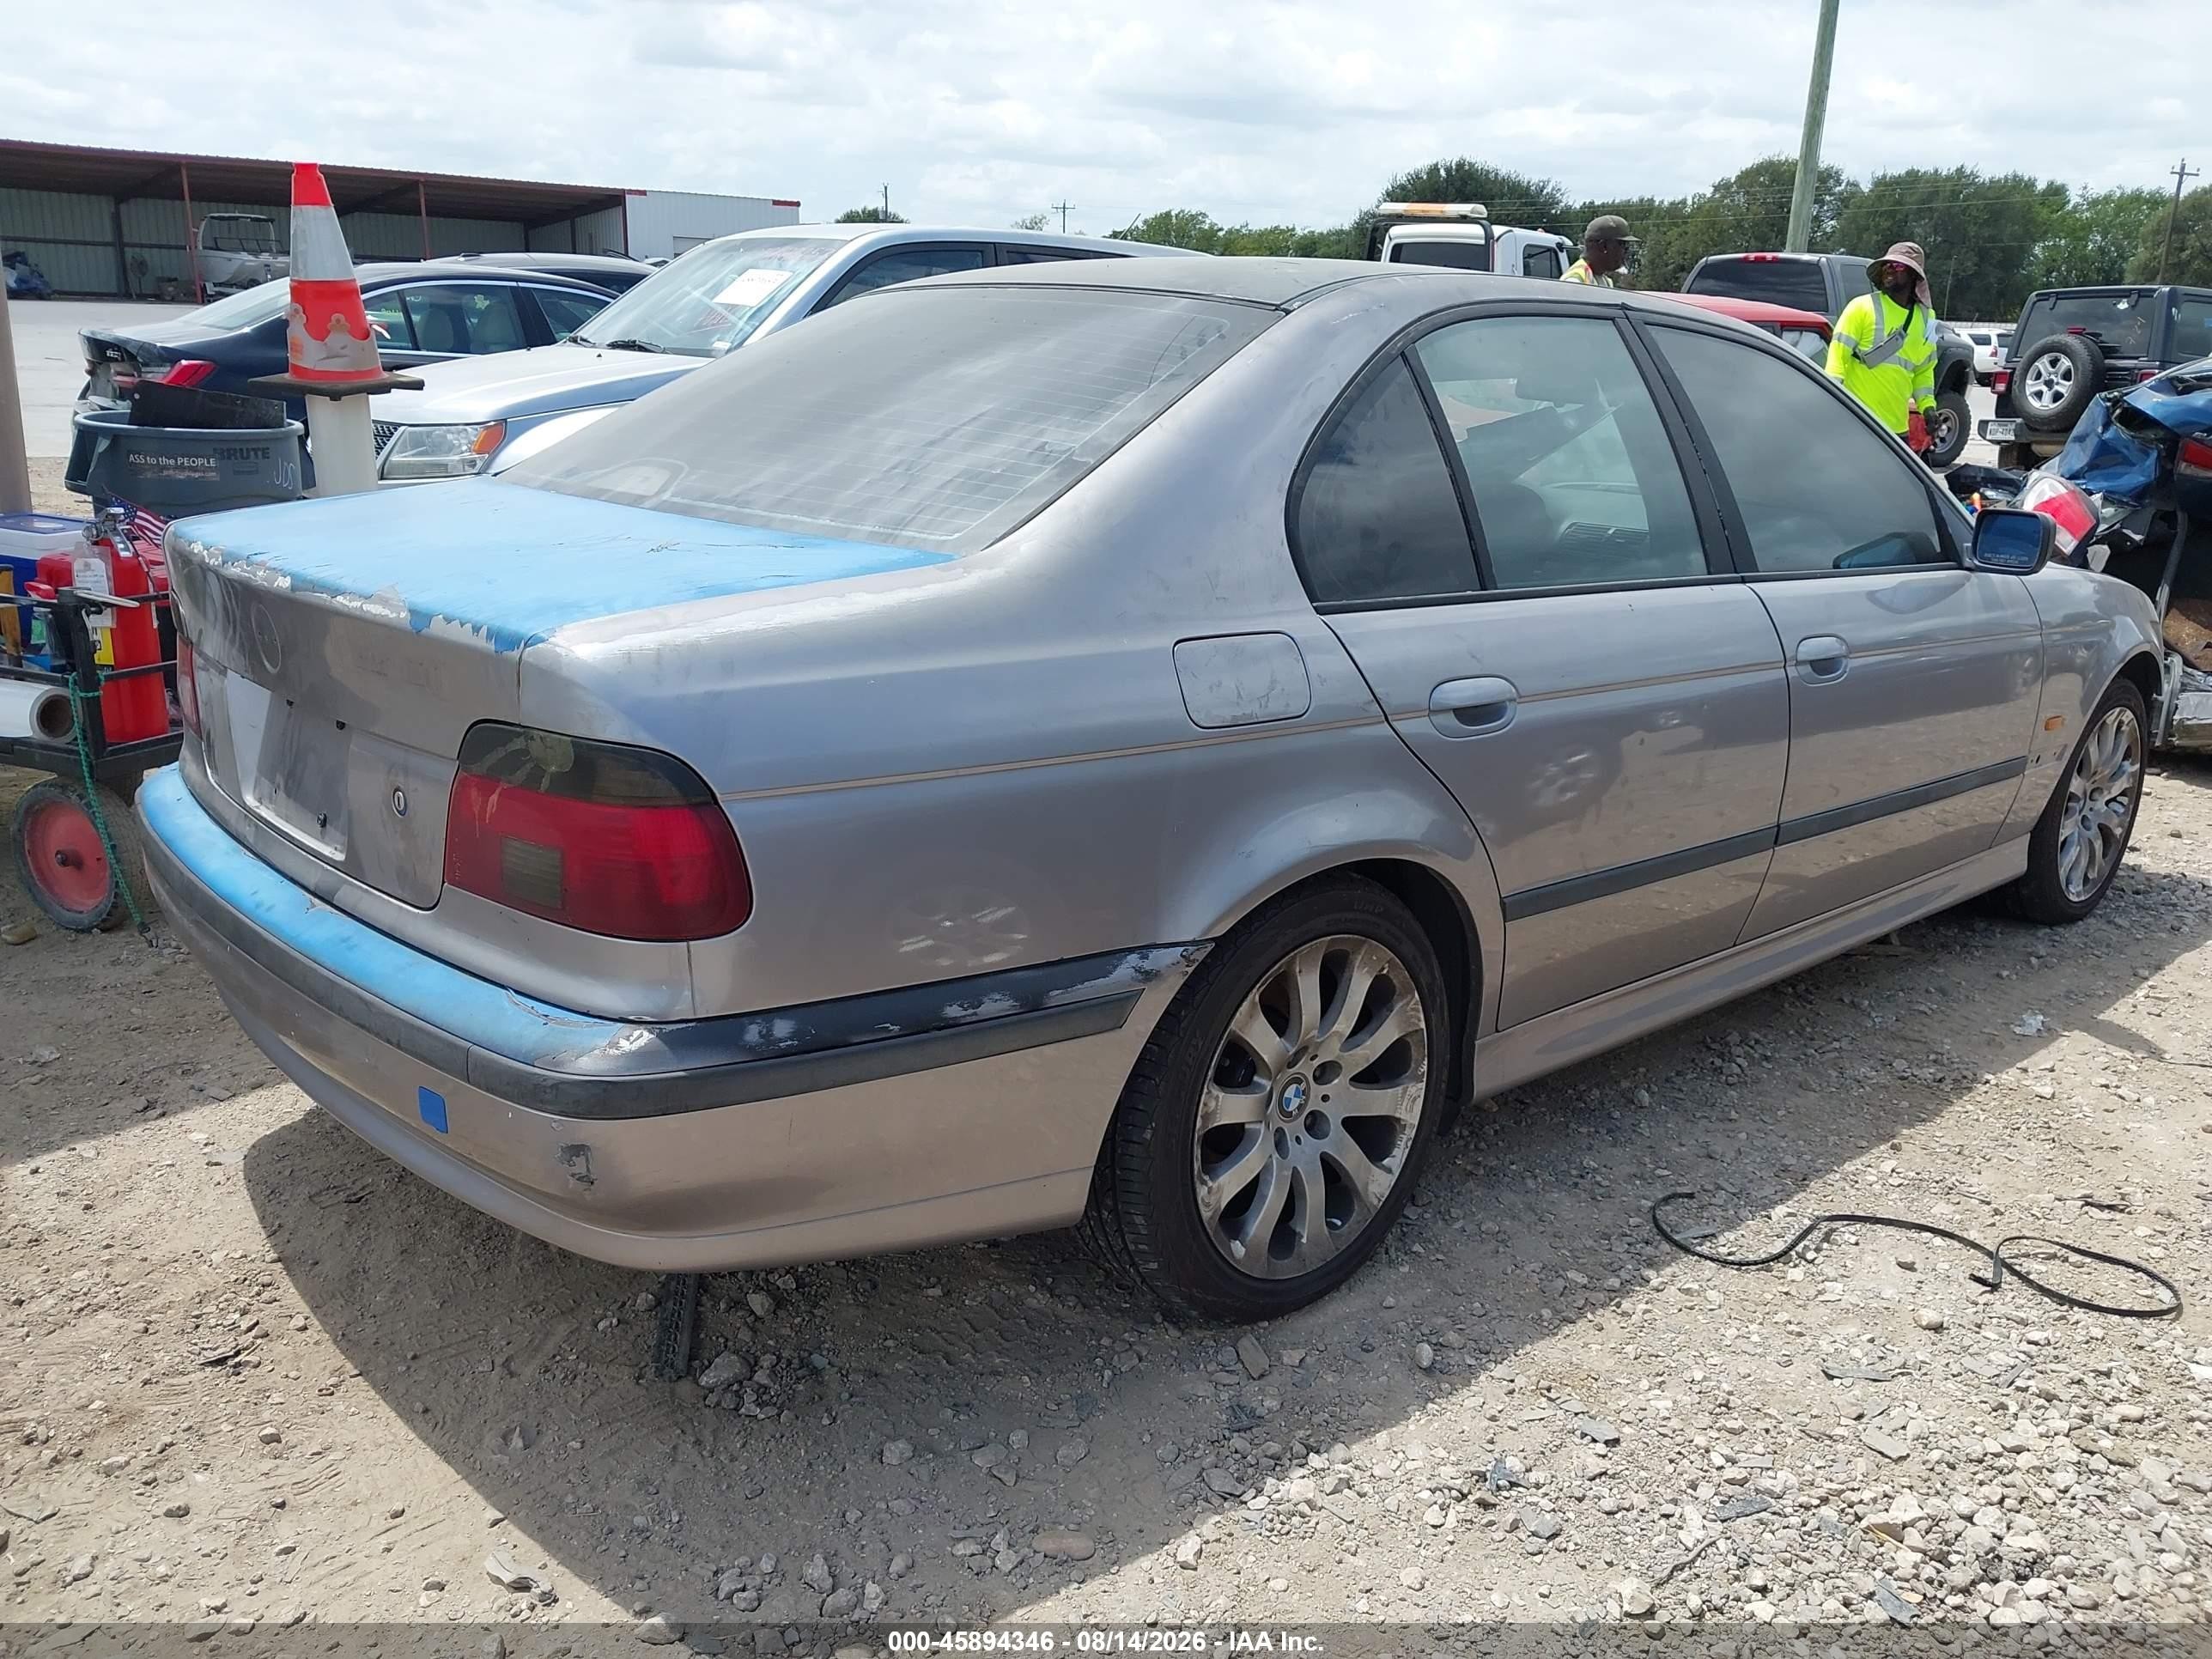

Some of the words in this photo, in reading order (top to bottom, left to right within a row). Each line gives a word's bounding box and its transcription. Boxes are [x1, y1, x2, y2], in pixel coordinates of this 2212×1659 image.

[213, 447, 270, 461] BRUTE
[146, 456, 157, 465] to
[158, 455, 175, 465] the
[177, 457, 216, 467] PEOPLE
